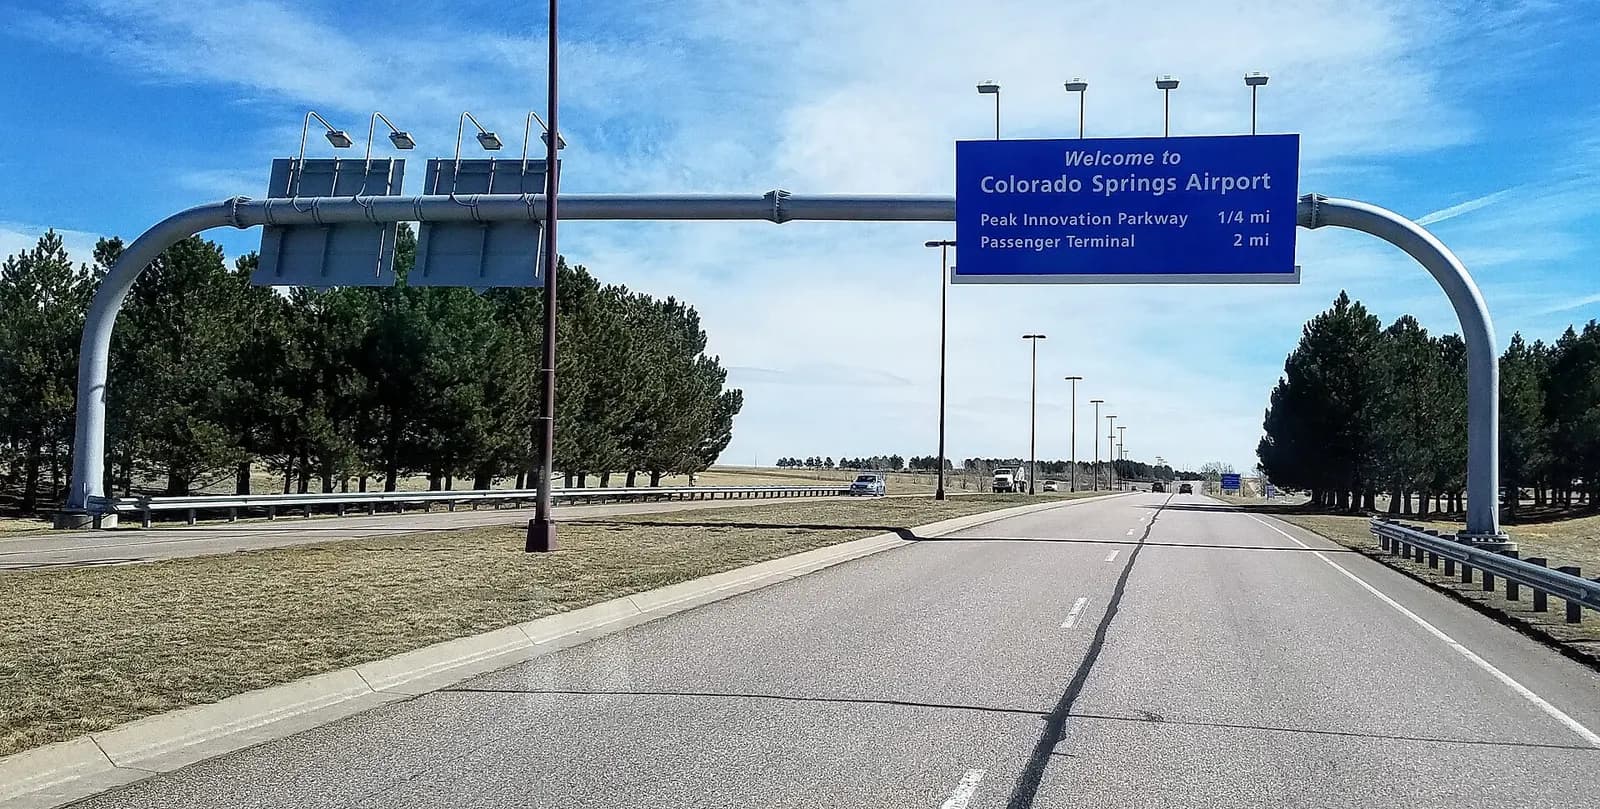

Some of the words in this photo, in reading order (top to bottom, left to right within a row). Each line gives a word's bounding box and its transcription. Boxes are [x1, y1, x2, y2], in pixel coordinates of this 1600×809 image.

[1065, 151, 1155, 166] Welcome
[1162, 151, 1181, 164] to
[980, 175, 1082, 193] Colorado
[1092, 174, 1177, 196] Springs
[1185, 172, 1271, 193] Airport
[981, 213, 1018, 226] Peak
[1023, 213, 1112, 225] Innovation
[1118, 212, 1189, 227] Parkway
[1218, 211, 1244, 223] 1/4
[1250, 210, 1270, 223] mi
[981, 236, 1061, 251] Passenger
[1065, 234, 1135, 247] Terminal
[1233, 234, 1243, 246] 2
[1249, 233, 1269, 246] mi
